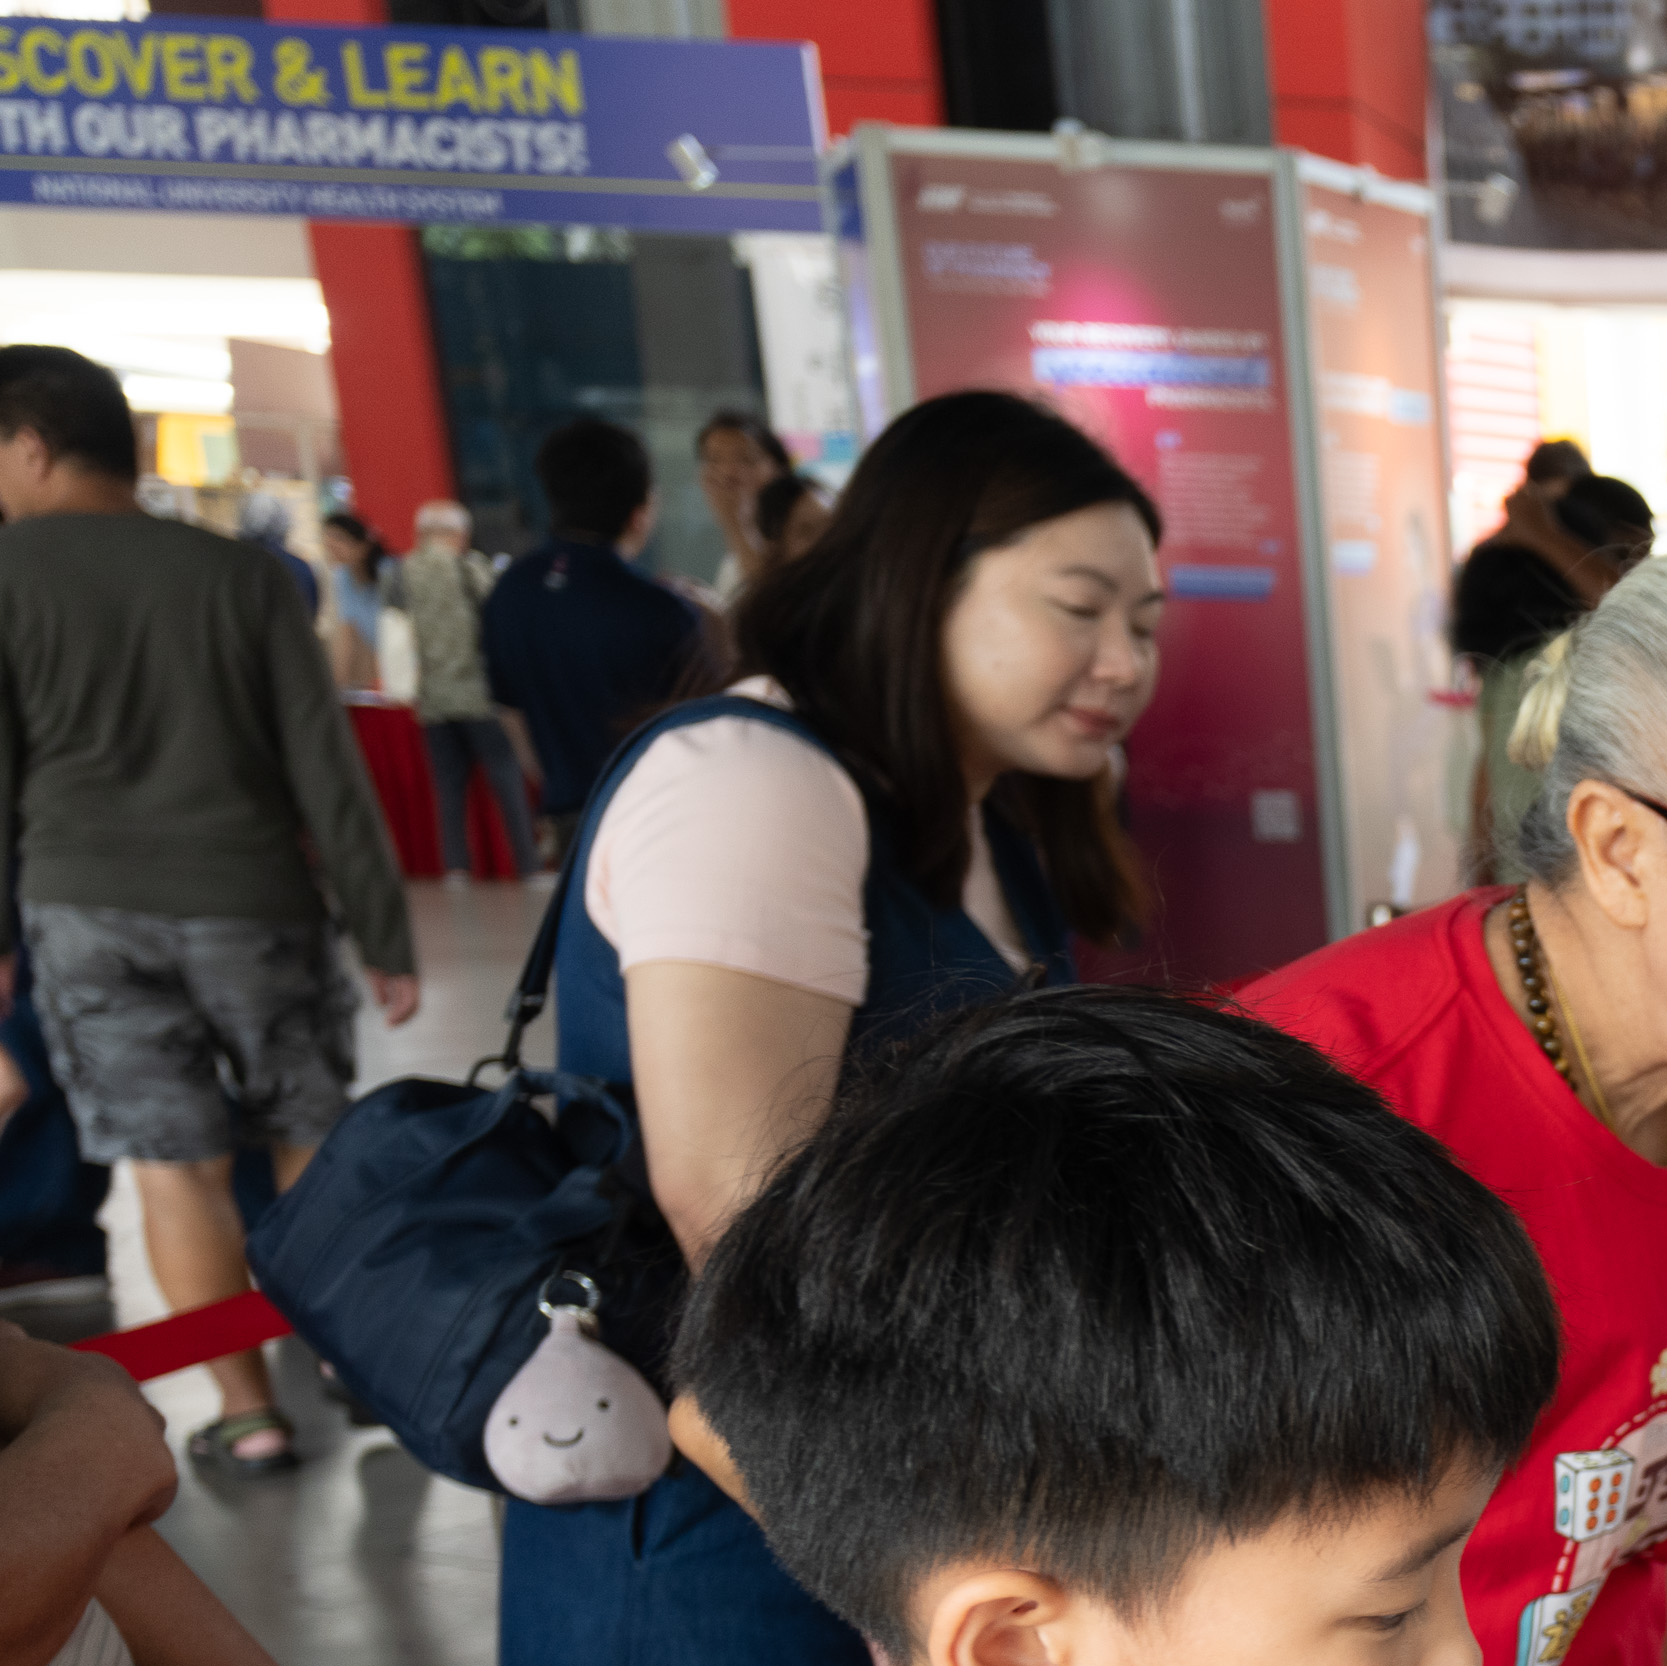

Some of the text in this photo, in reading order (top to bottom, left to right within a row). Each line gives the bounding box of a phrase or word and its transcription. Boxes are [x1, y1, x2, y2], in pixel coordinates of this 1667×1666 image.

[272, 37, 331, 108] &
[340, 39, 586, 116] LEARN
[72, 101, 192, 160] OUR
[193, 105, 589, 173] PHARMACISTS!
